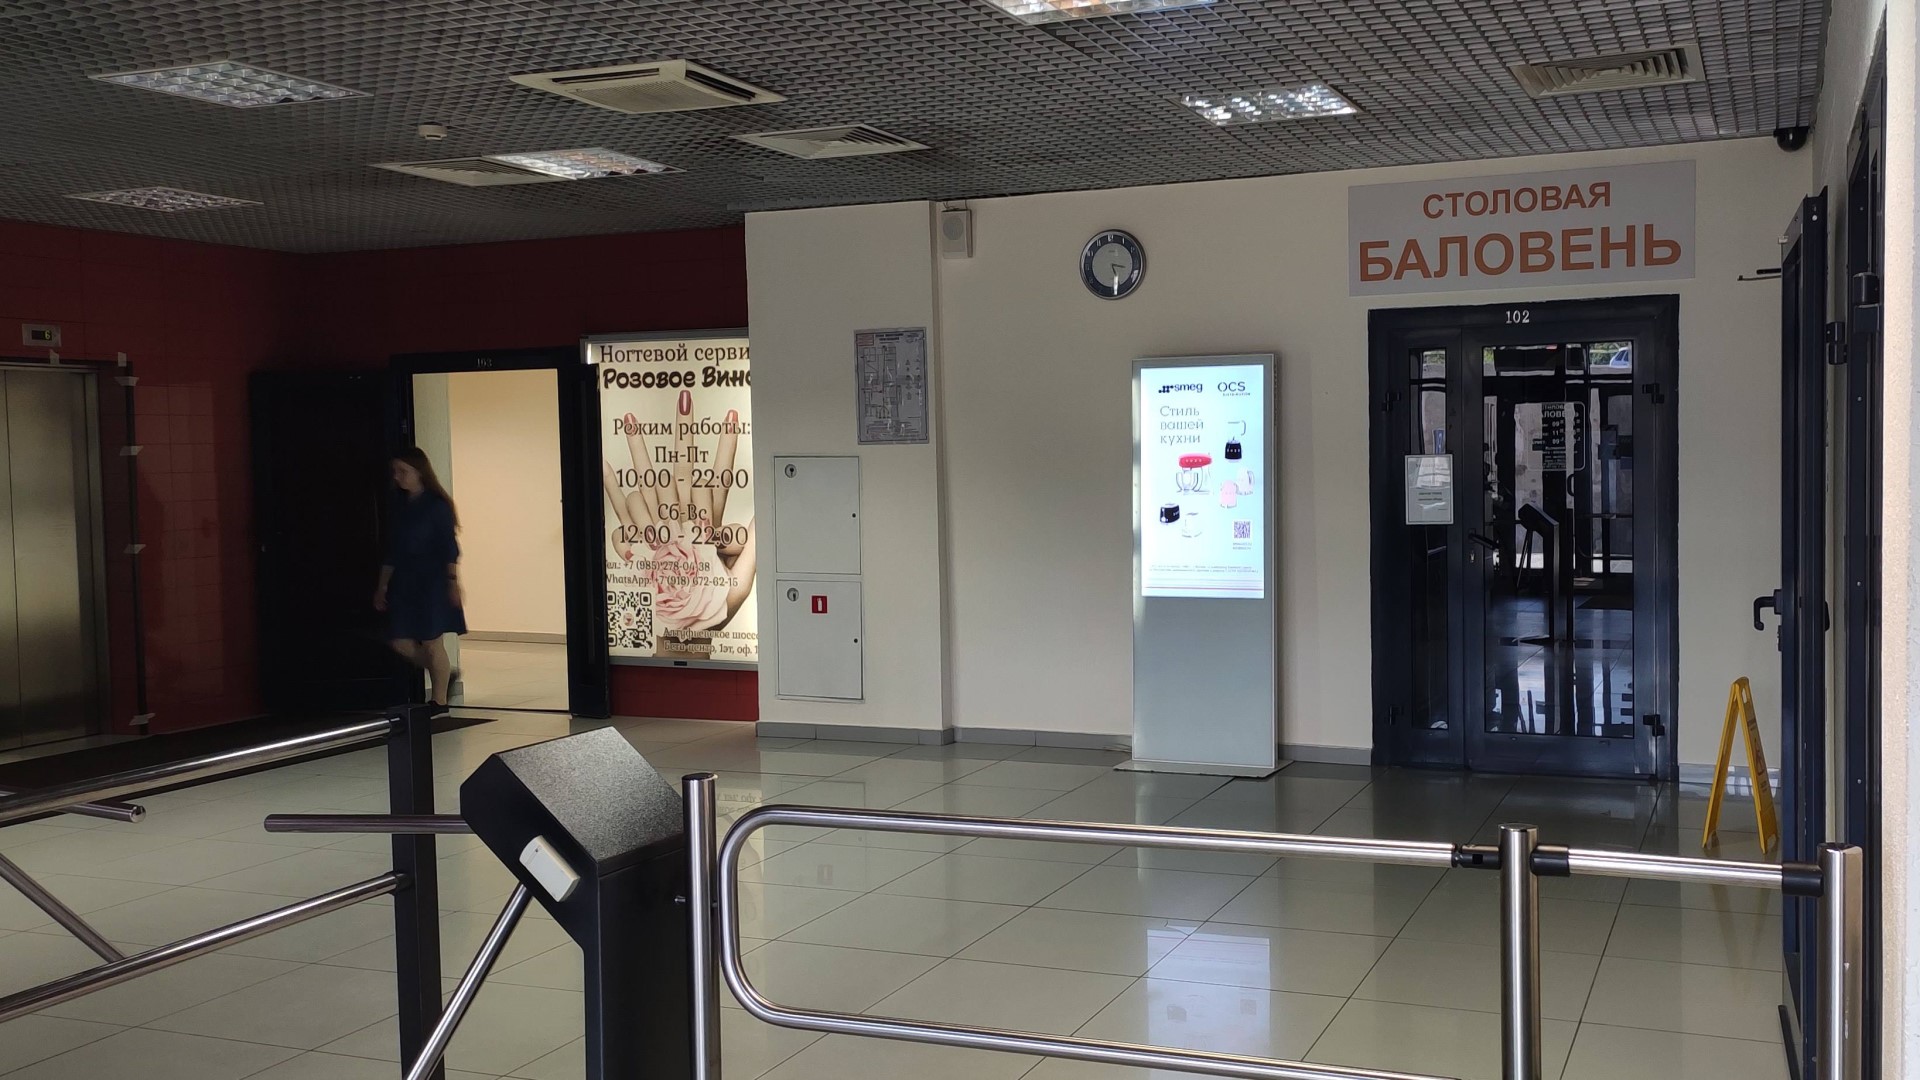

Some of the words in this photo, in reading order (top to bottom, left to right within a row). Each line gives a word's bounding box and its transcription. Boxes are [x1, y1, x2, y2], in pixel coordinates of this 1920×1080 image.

[1422, 181, 1611, 219] СТОЛОВАЯ
[1359, 223, 1682, 282] БАЛОВЕНЬ
[1505, 310, 1530, 324] 102
[45, 330, 51, 340] 6
[600, 343, 689, 363] Ногтевой
[603, 368, 696, 389] Розовое
[1174, 383, 1203, 393] smeg
[1217, 381, 1246, 392] OCS
[1159, 405, 1200, 417] Стиль
[613, 418, 673, 436] Режим
[678, 416, 751, 440] работы:
[1160, 418, 1204, 430] вашей
[1160, 435, 1201, 446] кухни
[655, 446, 709, 463] Пн-Пт
[616, 469, 671, 488] 10:00
[691, 469, 749, 489] 22:00
[658, 503, 707, 521] Сб-Вс
[618, 525, 671, 544] 12:00
[691, 525, 749, 546] 22:00
[624, 561, 633, 570] +7
[636, 560, 660, 571] (985)
[667, 575, 690, 586] (918)
[693, 576, 739, 587] 672-62-15
